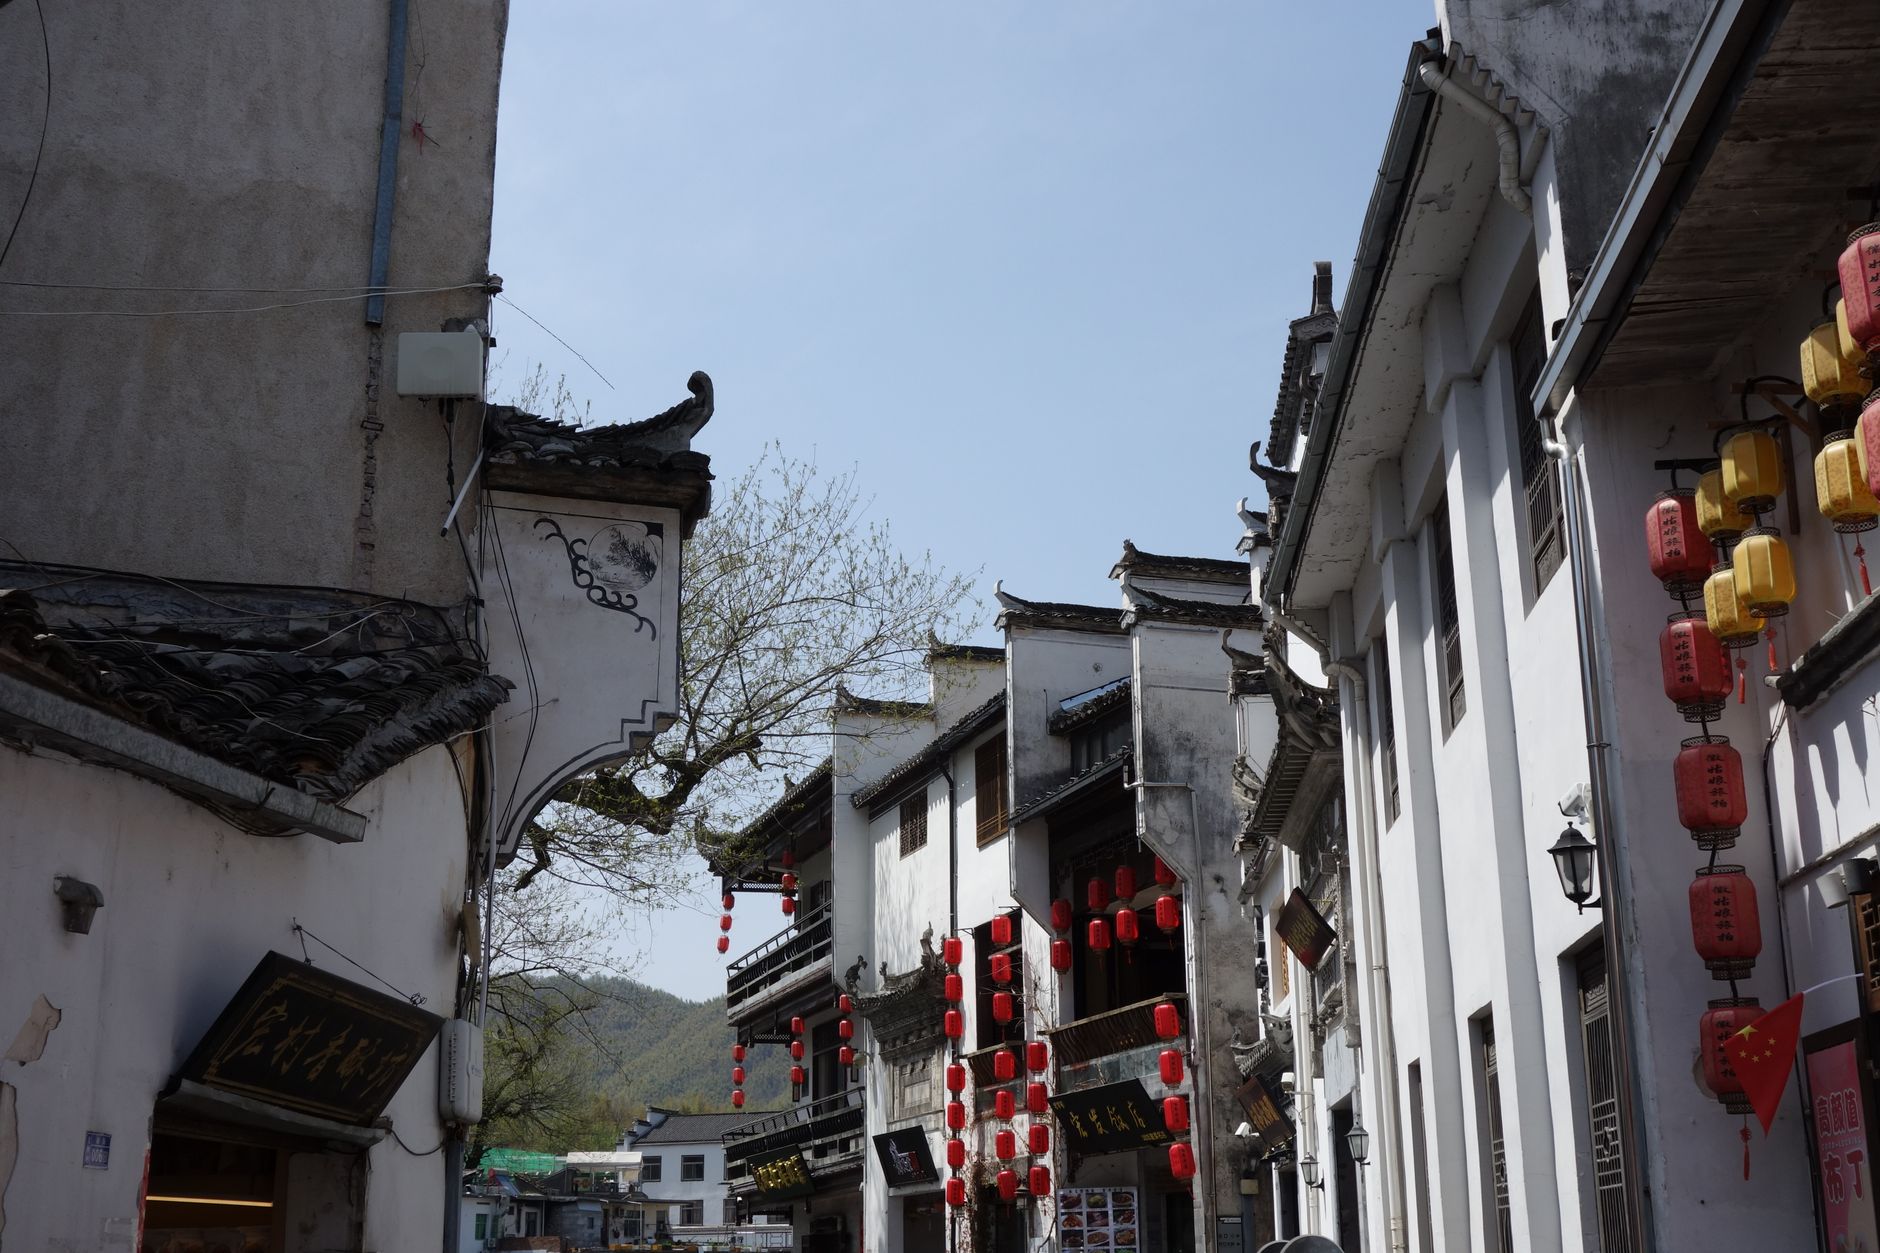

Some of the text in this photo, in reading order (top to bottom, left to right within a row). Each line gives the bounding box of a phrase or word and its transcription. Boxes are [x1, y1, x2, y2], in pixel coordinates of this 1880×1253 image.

[1817, 1088, 1861, 1137] 高颜值
[1823, 1148, 1865, 1204] 布丁
